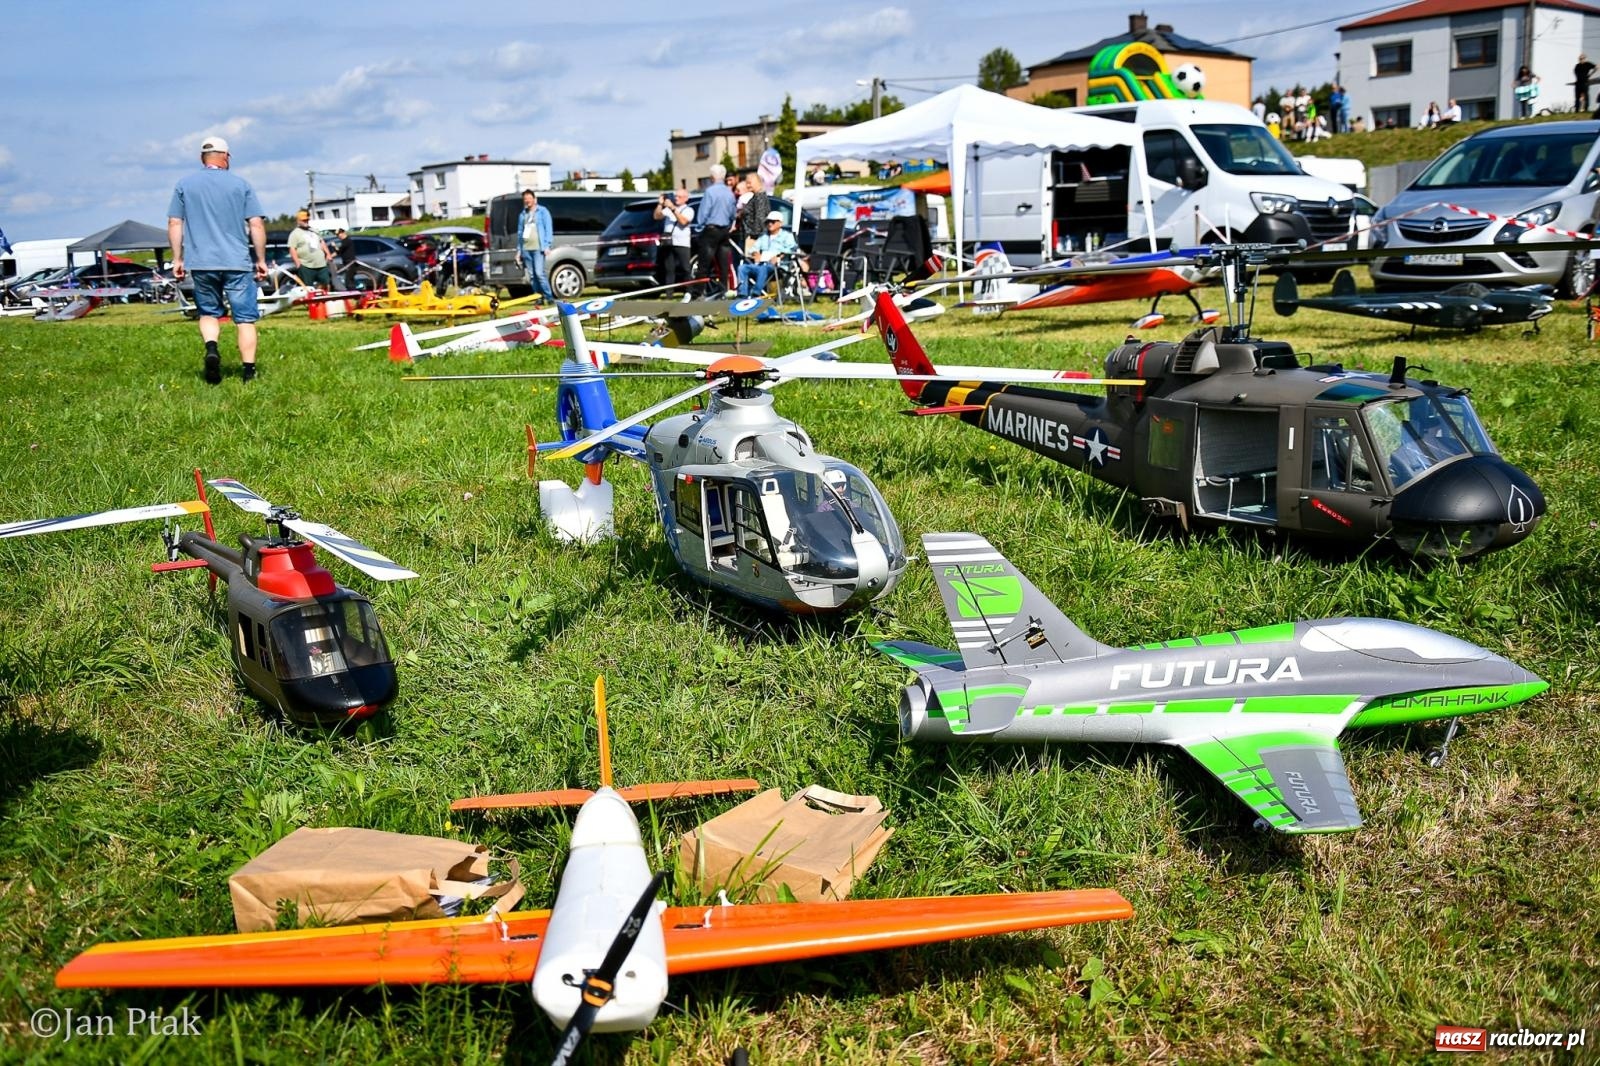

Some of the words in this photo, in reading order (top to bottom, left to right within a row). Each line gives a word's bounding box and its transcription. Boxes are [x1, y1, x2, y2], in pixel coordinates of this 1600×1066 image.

[987, 405, 1070, 452] MARINES
[943, 563, 1005, 577] FUTURA
[1110, 656, 1304, 690] FUTURA
[1378, 691, 1509, 709] TOMAHAWK
[1284, 771, 1321, 814] FUTURA
